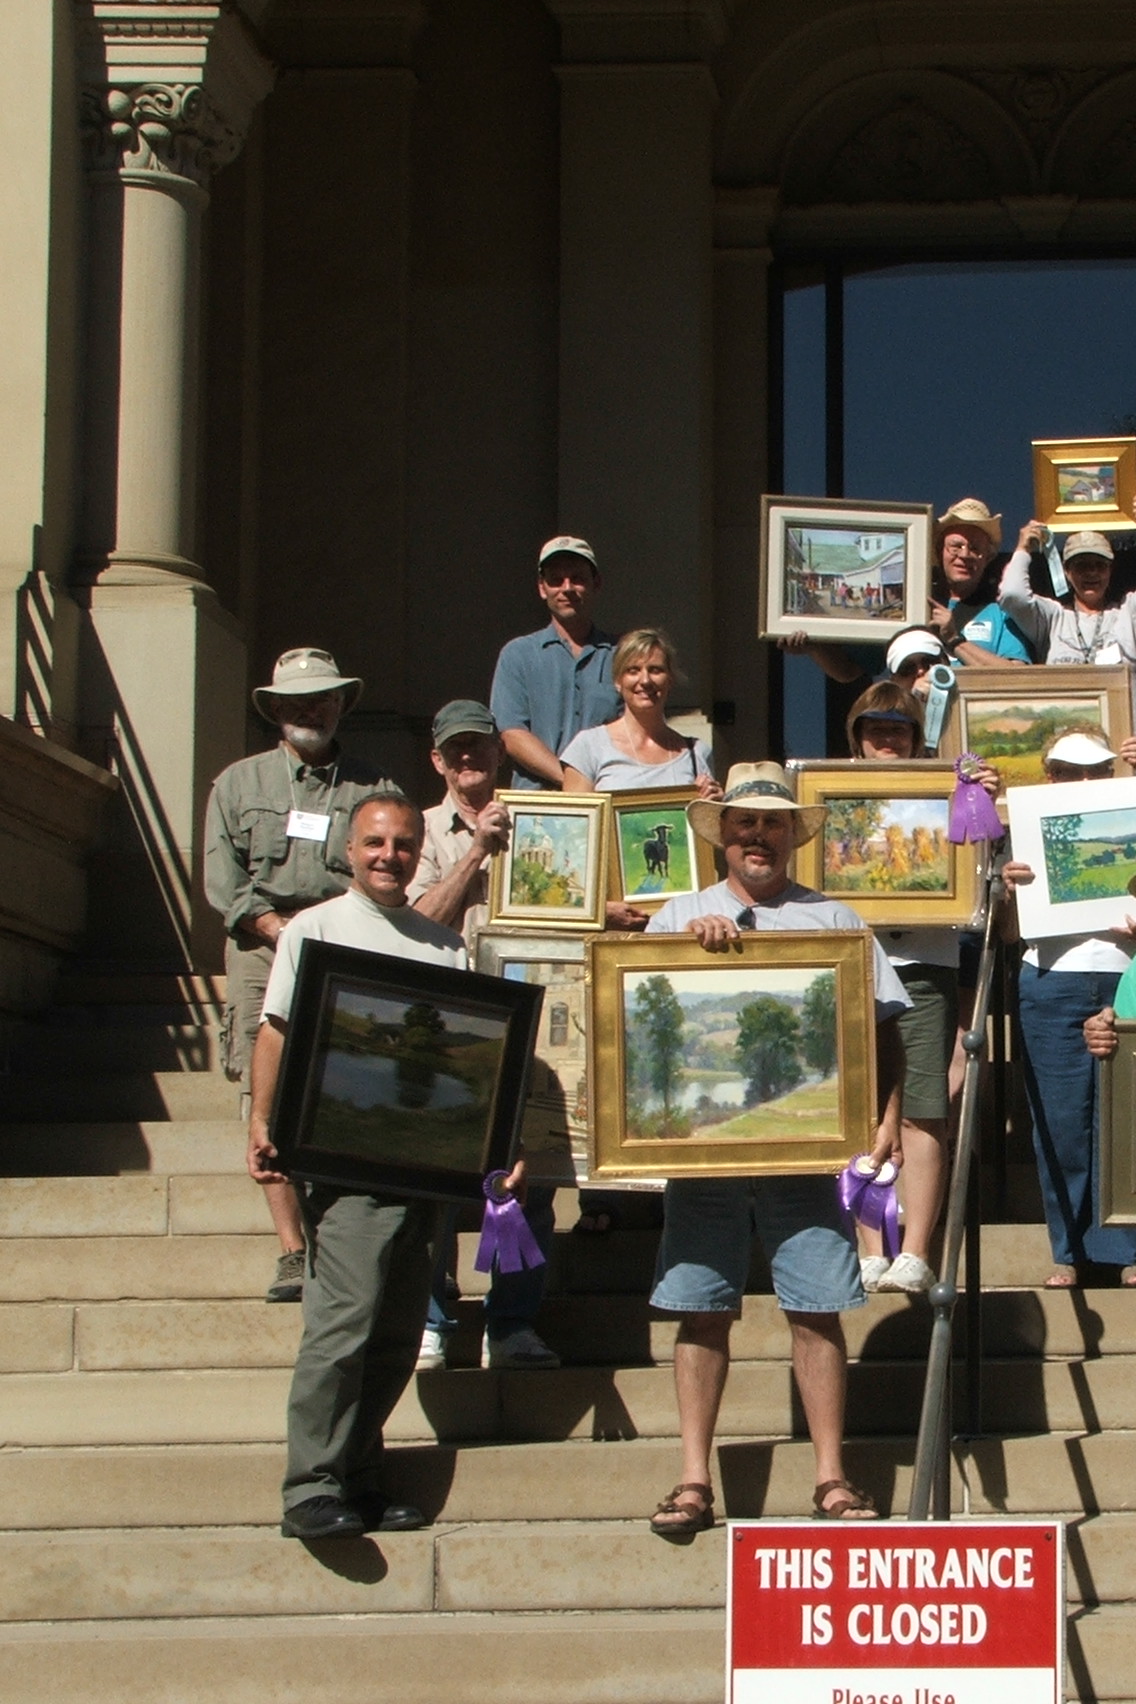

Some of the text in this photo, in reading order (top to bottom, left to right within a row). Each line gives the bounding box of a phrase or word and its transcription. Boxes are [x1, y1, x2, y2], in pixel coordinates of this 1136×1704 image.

[755, 1548, 1035, 1589] THIS ENTRANCE
[801, 1603, 988, 1645] IS CLOSED
